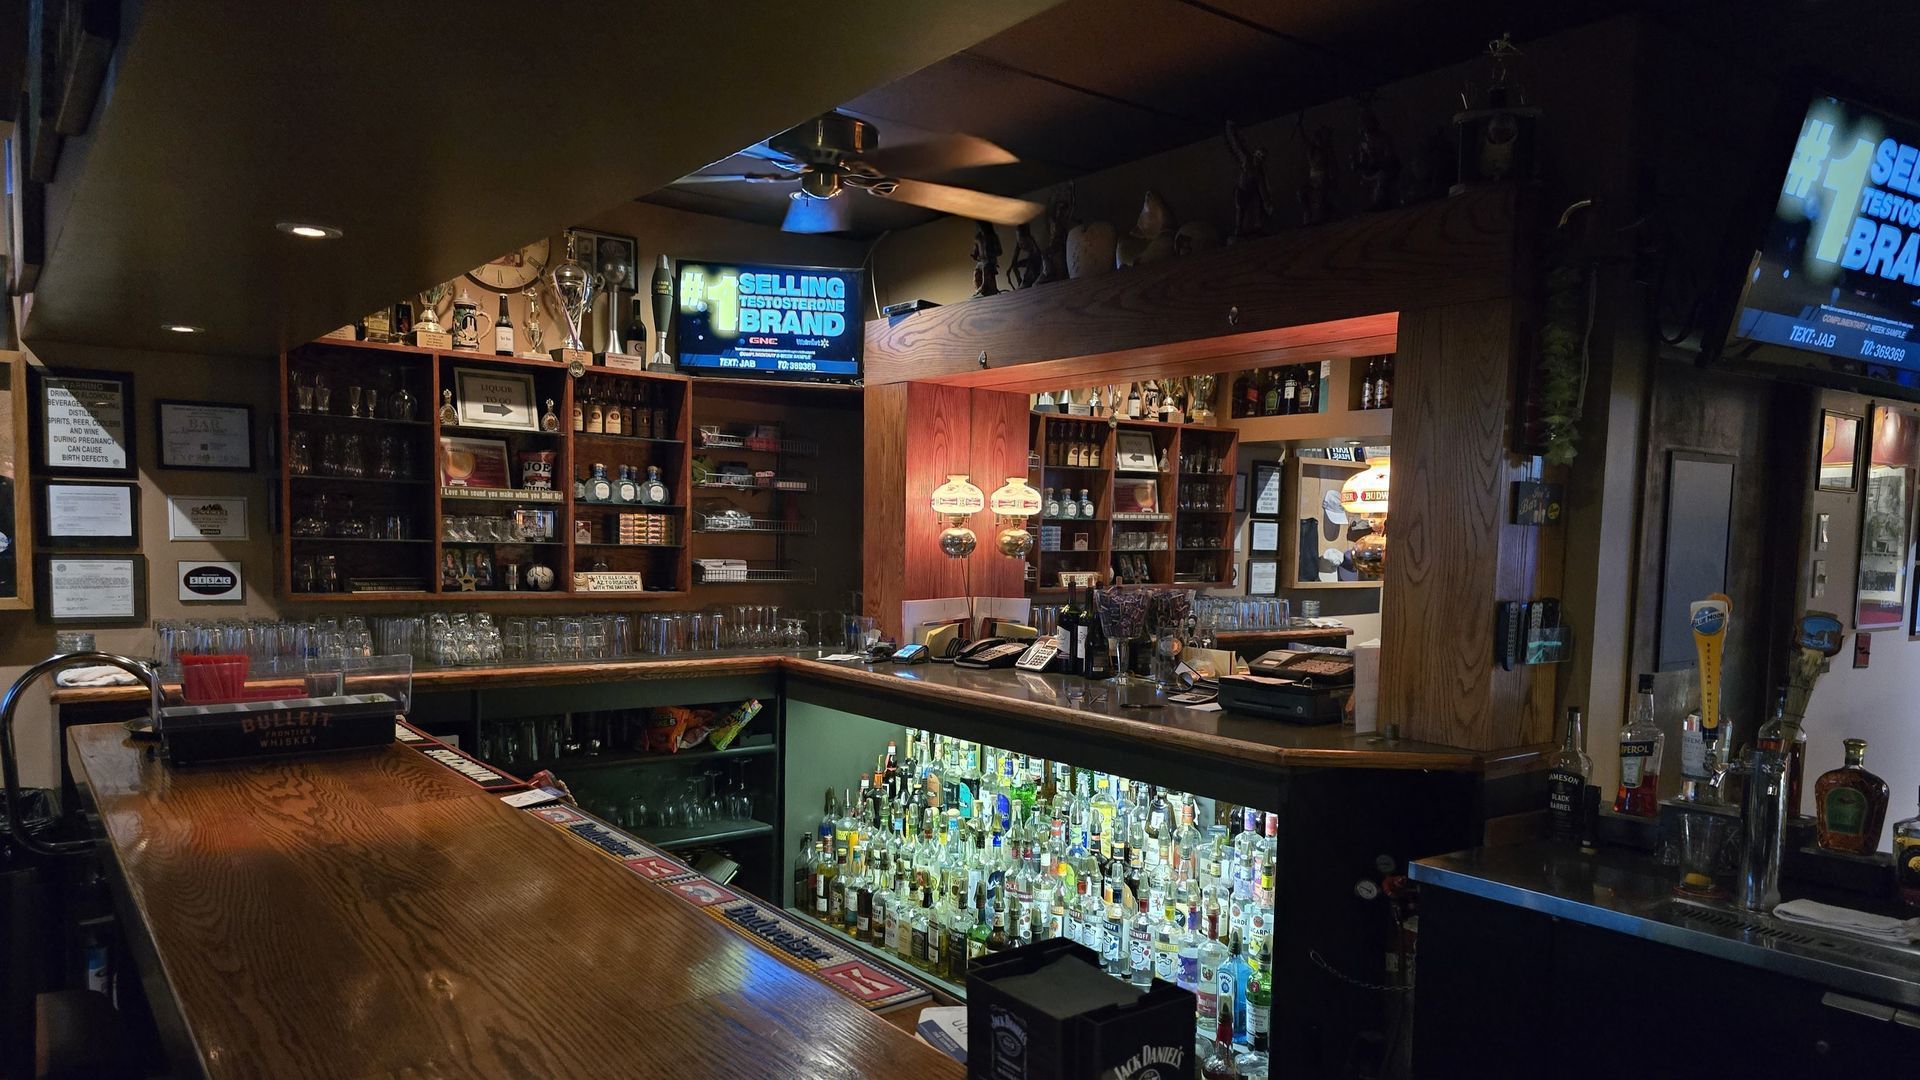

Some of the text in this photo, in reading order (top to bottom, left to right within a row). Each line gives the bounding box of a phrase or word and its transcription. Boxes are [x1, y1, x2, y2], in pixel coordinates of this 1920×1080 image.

[1784, 118, 1875, 263] #1
[738, 272, 845, 299] SELLING
[681, 272, 737, 331] #1
[739, 295, 845, 313] TESTOSTERONE
[739, 308, 845, 337] BRAND
[749, 337, 778, 345] GNC
[1789, 325, 1906, 362] TEXT: JAB TO: 369369
[720, 357, 739, 367] TEXT:
[739, 359, 756, 368] JAB
[778, 360, 789, 370] TO:
[481, 383, 513, 393] LIQUOR
[485, 395, 512, 405] TO GO
[78, 437, 115, 445] PREGNANCY
[81, 455, 109, 463] DEFECTS
[524, 462, 551, 472] JOE
[444, 488, 458, 496] Love
[459, 488, 469, 496] the
[470, 489, 486, 497] sound
[488, 490, 498, 498] you
[500, 490, 514, 498] make
[515, 491, 529, 499] when
[530, 492, 540, 500] you
[541, 491, 553, 499] Shut
[1707, 611, 1725, 621] MOON
[241, 711, 333, 734] BULLEIT
[260, 735, 317, 748] WHISKEY
[724, 903, 834, 961] Budweiser
[1113, 1044, 1185, 1080] JACK DANIEL'S
